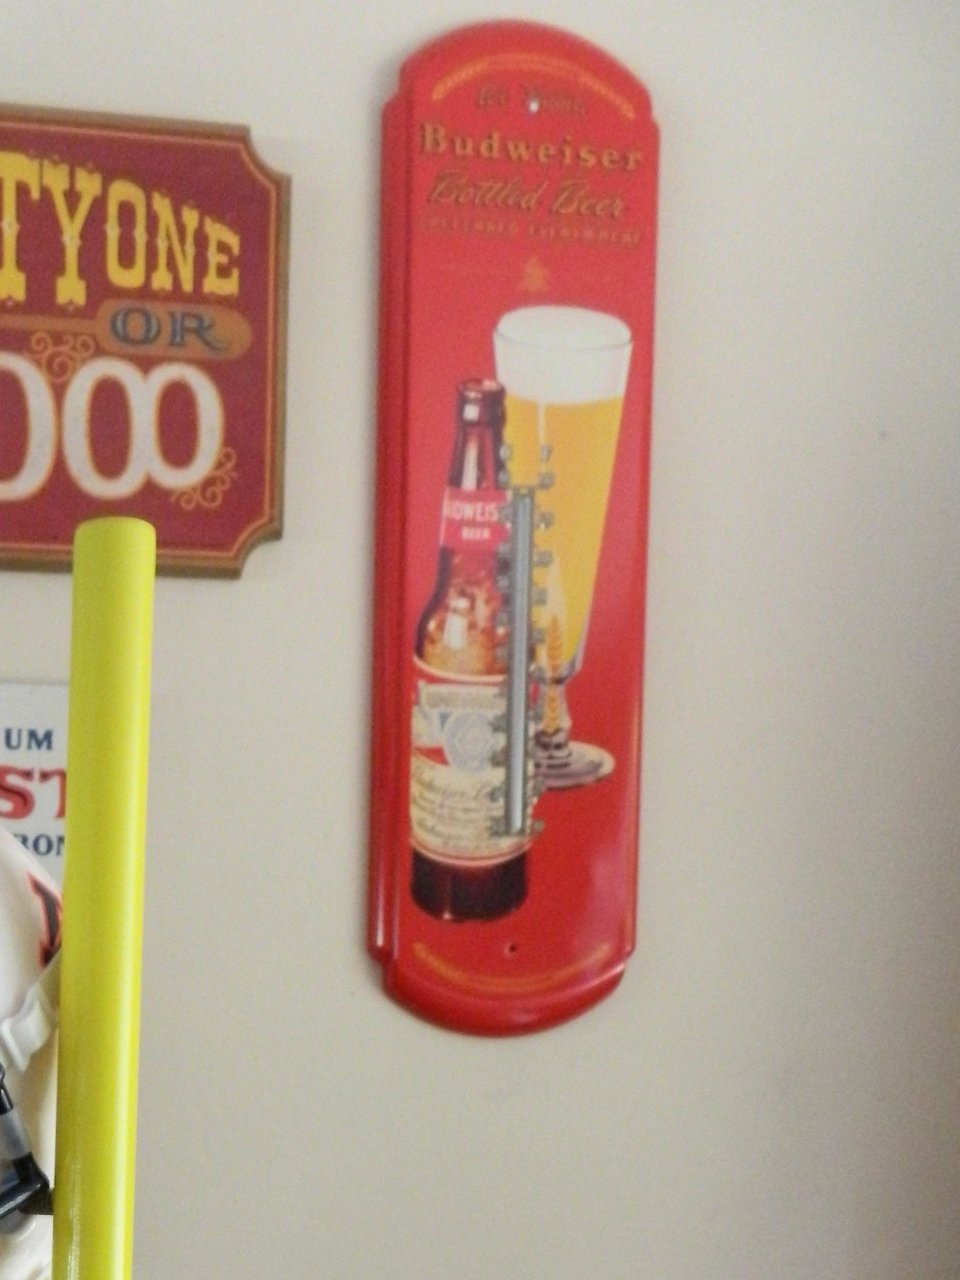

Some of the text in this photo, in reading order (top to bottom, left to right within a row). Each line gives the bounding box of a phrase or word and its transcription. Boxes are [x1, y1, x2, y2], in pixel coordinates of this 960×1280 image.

[422, 123, 642, 171] Budweiser
[429, 169, 625, 218] Bottled Beer
[111, 307, 230, 353] OR
